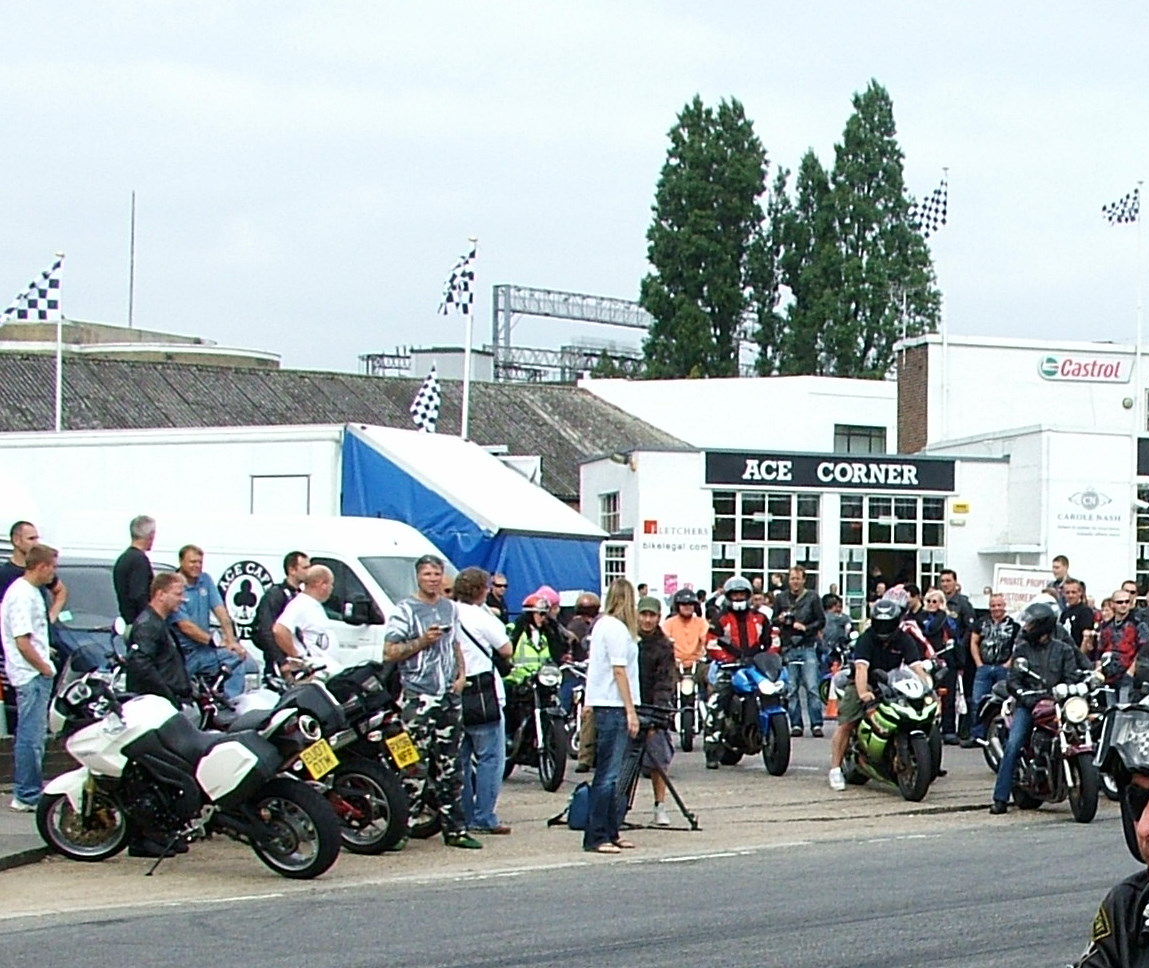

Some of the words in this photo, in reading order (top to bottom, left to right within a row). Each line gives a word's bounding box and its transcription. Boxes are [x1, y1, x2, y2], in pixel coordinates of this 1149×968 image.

[1061, 359, 1121, 379] Castrol
[742, 459, 793, 481] ACE
[817, 462, 919, 486] CORNER
[1057, 513, 1094, 521] CAROLE
[1096, 514, 1121, 522] NASH
[219, 564, 243, 591] ACE
